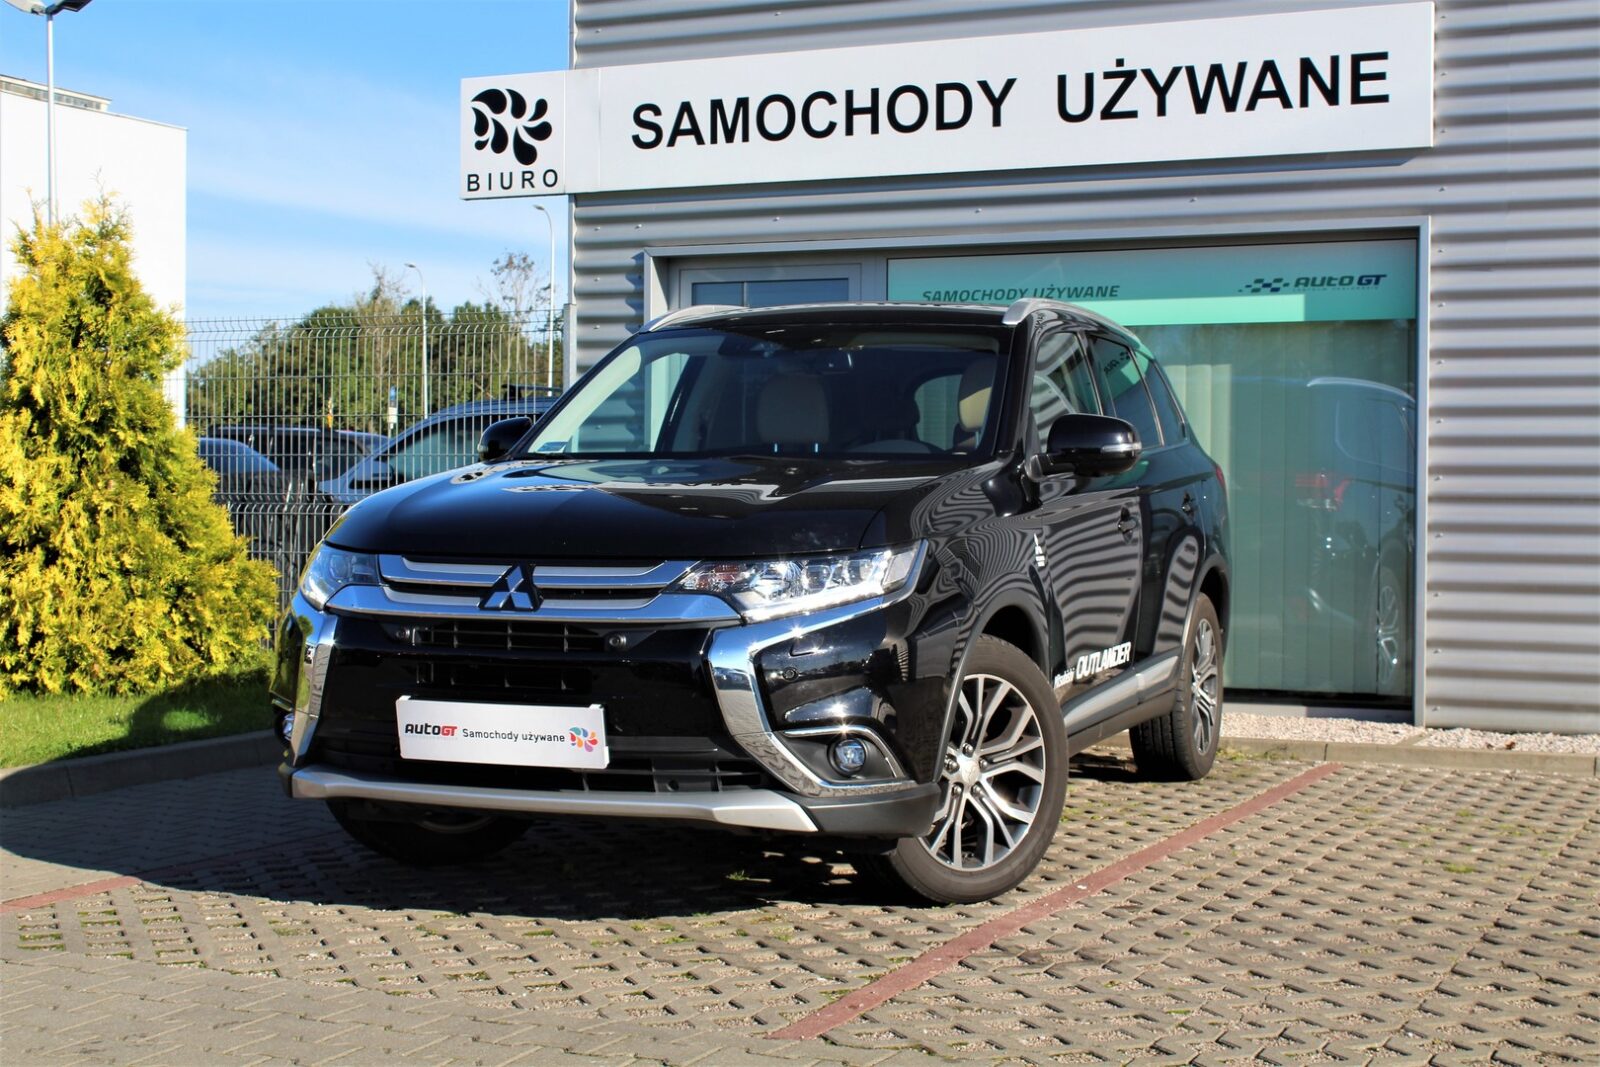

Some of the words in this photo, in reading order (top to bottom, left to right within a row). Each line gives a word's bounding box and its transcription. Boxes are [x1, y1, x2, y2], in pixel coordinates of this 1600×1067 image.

[632, 77, 1017, 150] SAMOCHODY
[1058, 51, 1390, 123] UŻYWANE
[468, 168, 559, 192] BIURO
[922, 287, 1028, 302] SAMOCHODY
[1033, 284, 1120, 299] UŻYWANE
[1076, 641, 1132, 680] OUTLANDER
[462, 728, 519, 743] Samochody
[521, 730, 565, 743] używane
